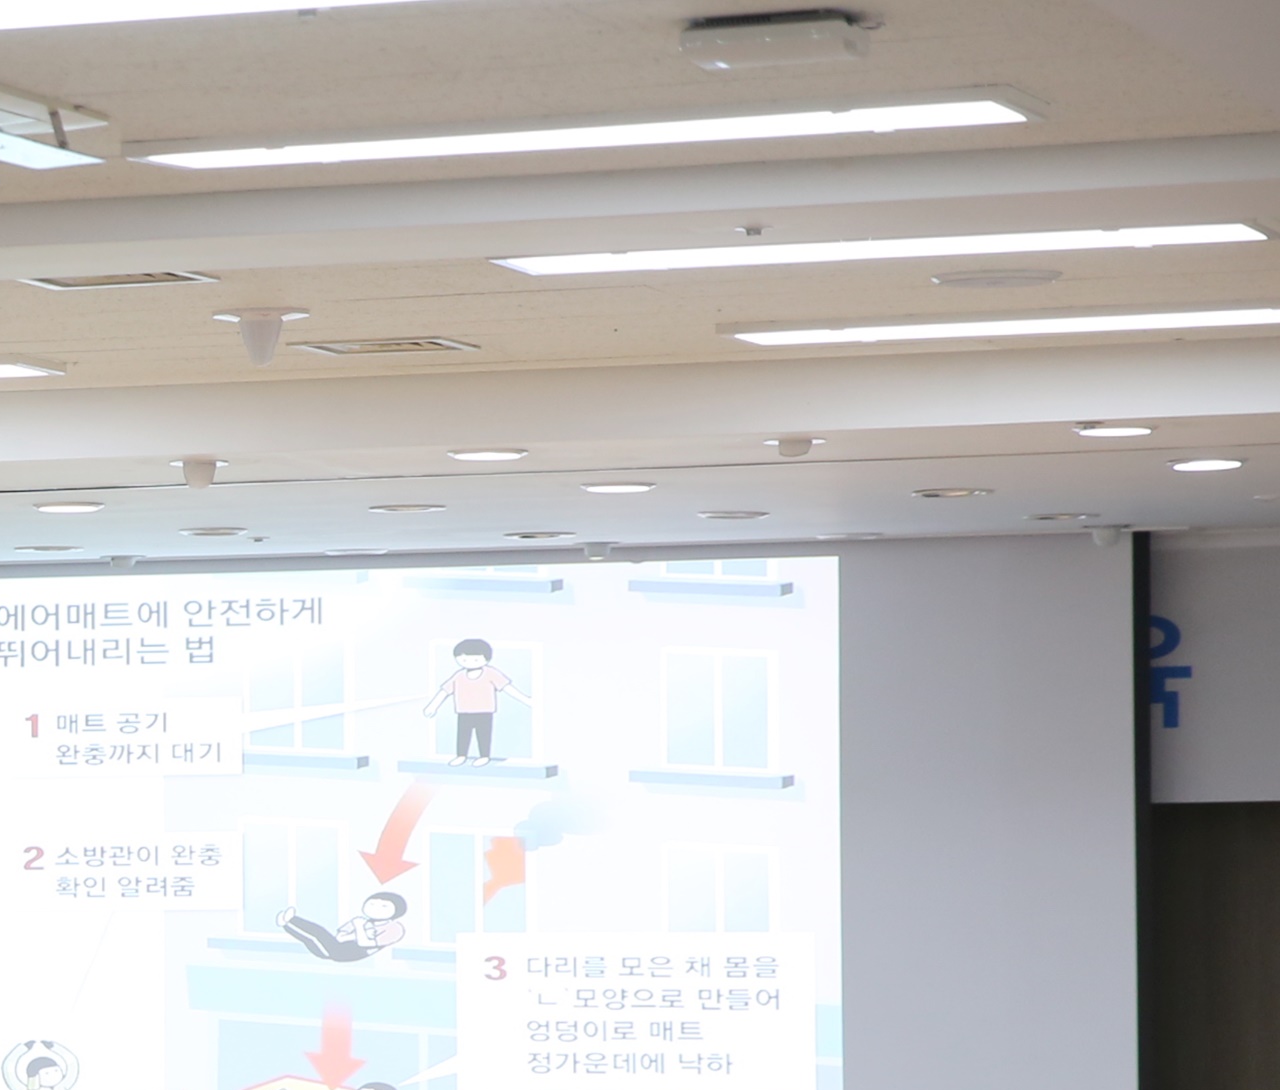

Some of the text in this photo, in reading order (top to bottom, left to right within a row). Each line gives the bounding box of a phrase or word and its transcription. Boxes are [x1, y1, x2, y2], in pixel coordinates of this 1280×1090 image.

[184, 597, 323, 627] 안전하게
[185, 635, 214, 664] 법
[25, 712, 168, 738] 1 매트 공기
[56, 742, 221, 766] 완충까지 대기
[23, 843, 222, 870] 2 소방관이 완충
[56, 876, 195, 898] 확인 알려줌
[484, 956, 779, 980] 3 다리를 모은 채 몸을
[698, 989, 779, 1010] 만들어
[527, 1020, 703, 1042] 엉덩이로 매트
[527, 1052, 733, 1074] 정가운데에 낙하
